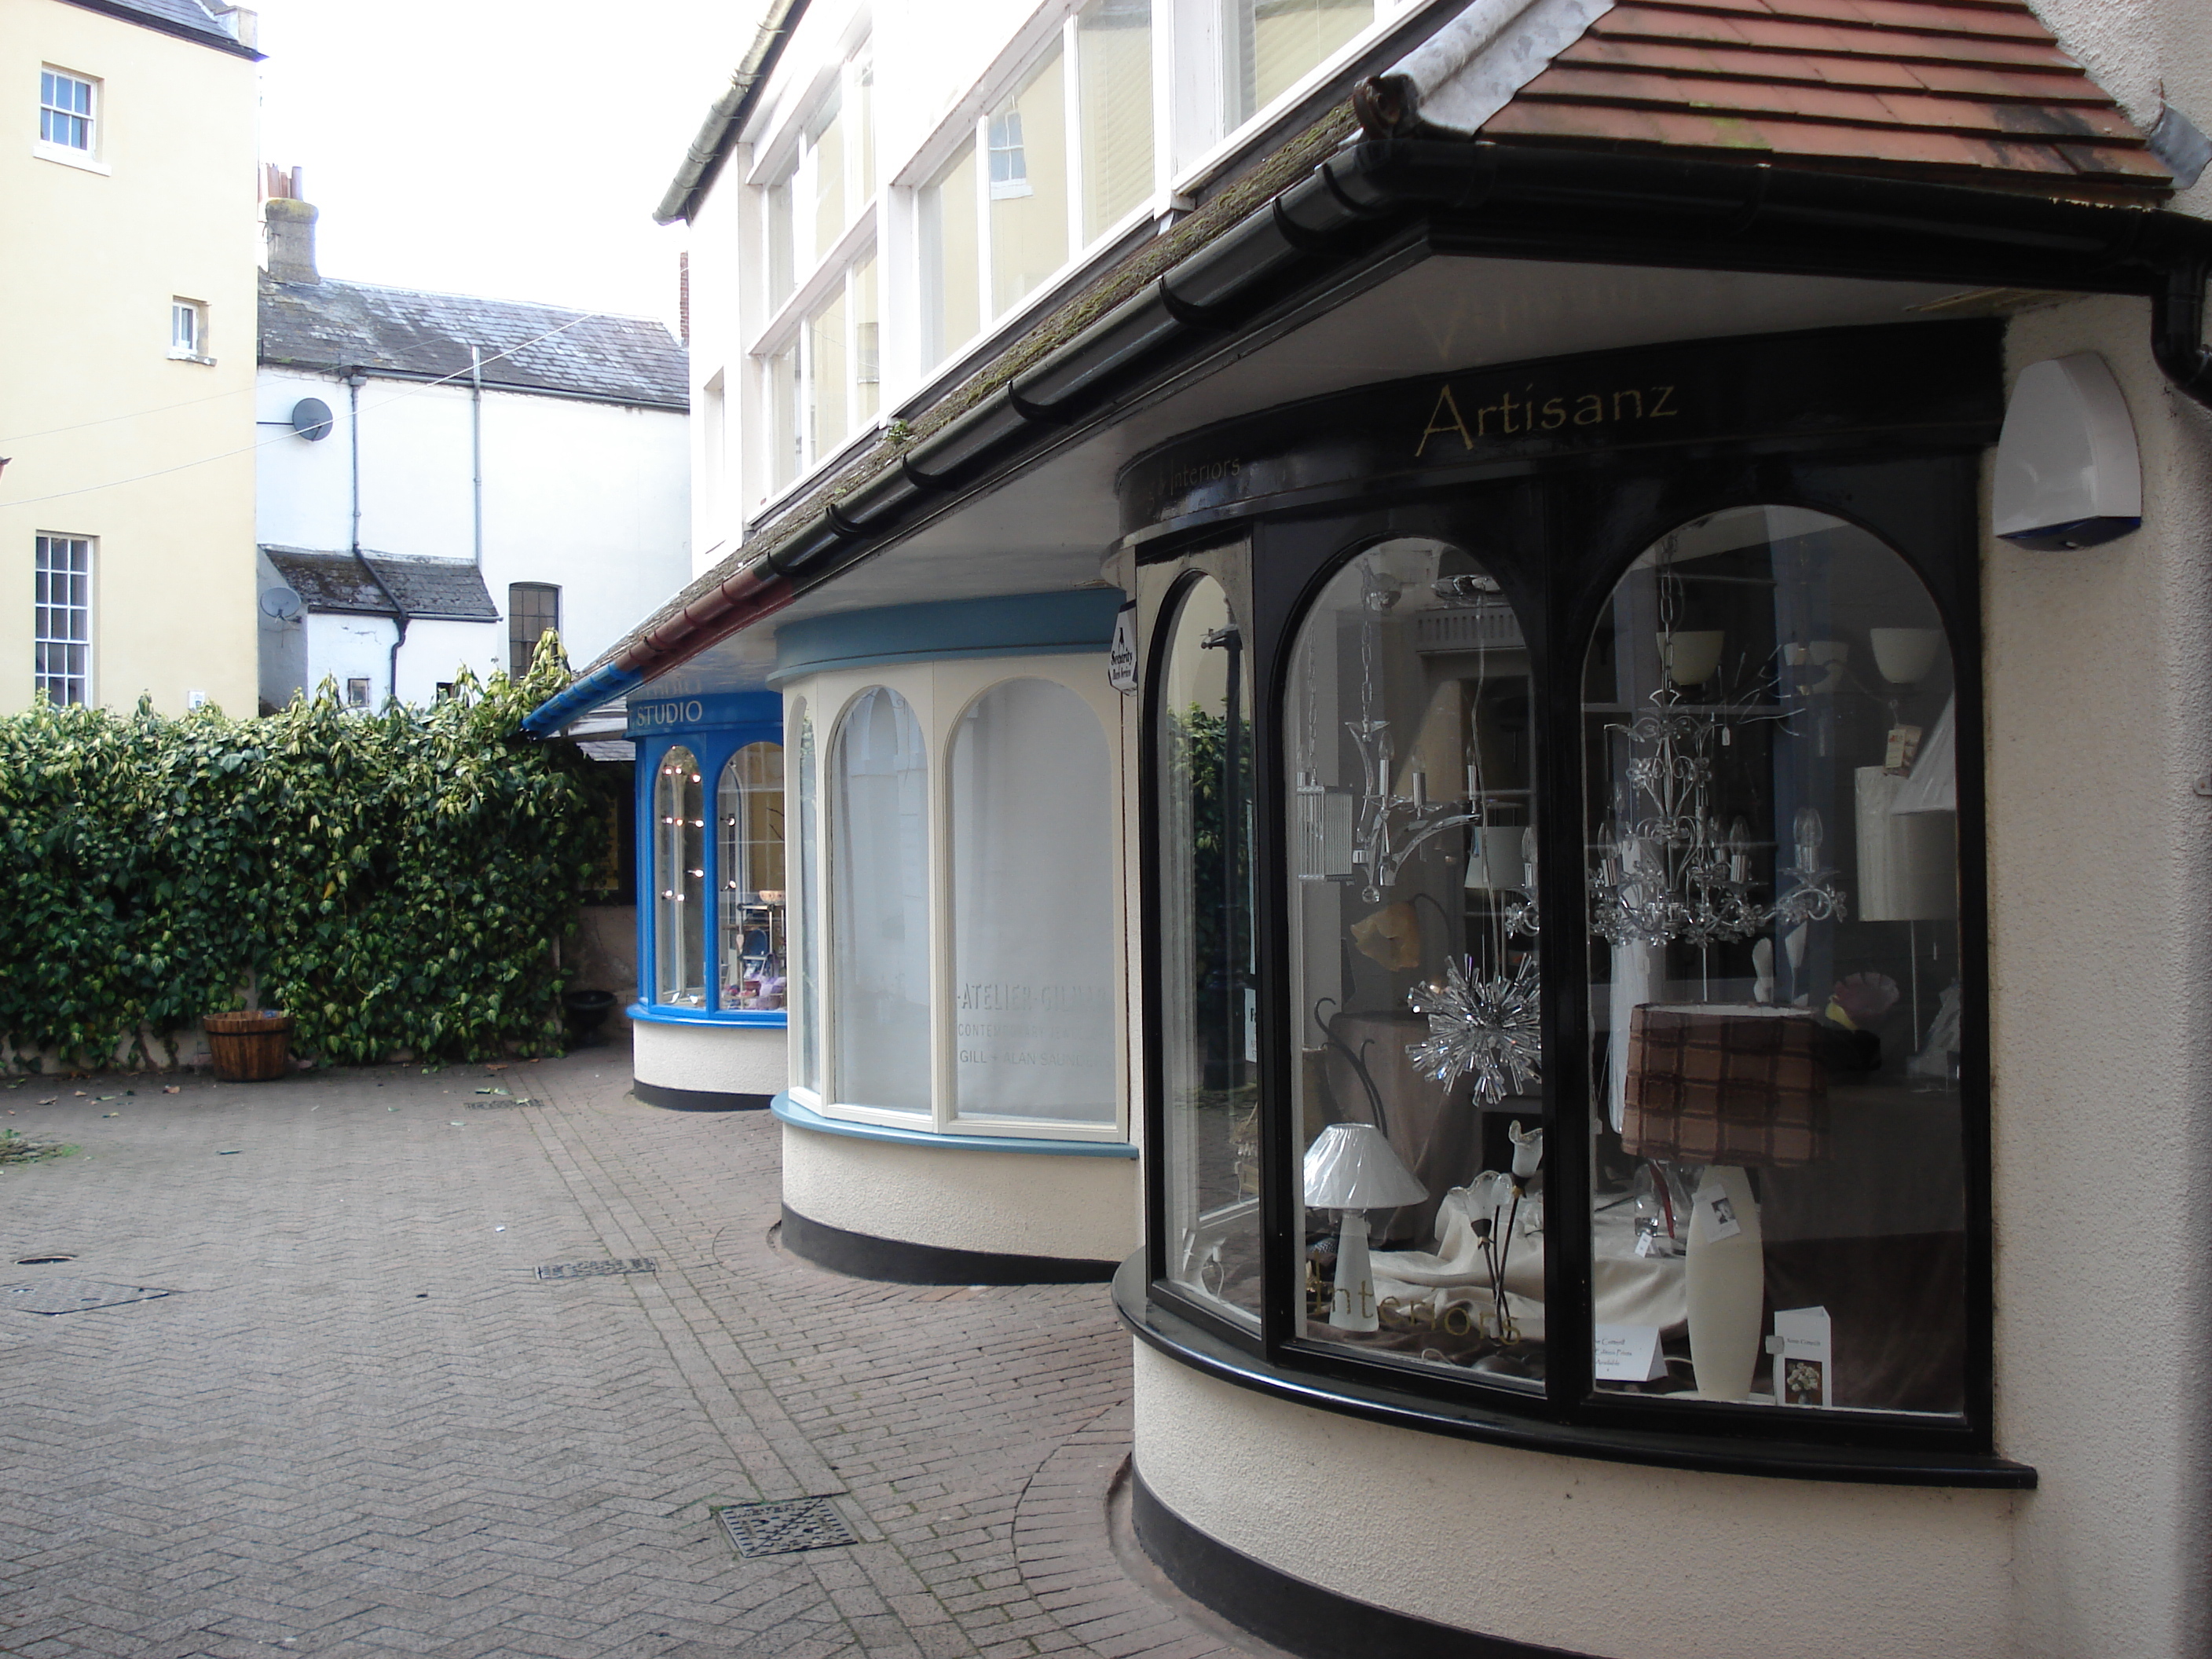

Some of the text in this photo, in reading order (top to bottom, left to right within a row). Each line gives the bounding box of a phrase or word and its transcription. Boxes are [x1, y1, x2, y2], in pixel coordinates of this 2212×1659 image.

[1415, 383, 1679, 458] Artisanz
[1170, 457, 1240, 496] Interiors
[637, 700, 703, 727] STUDIO
[959, 1049, 987, 1064] GILL
[1003, 1051, 1037, 1066] ALAN
[1313, 1251, 1522, 1346] Interiors
